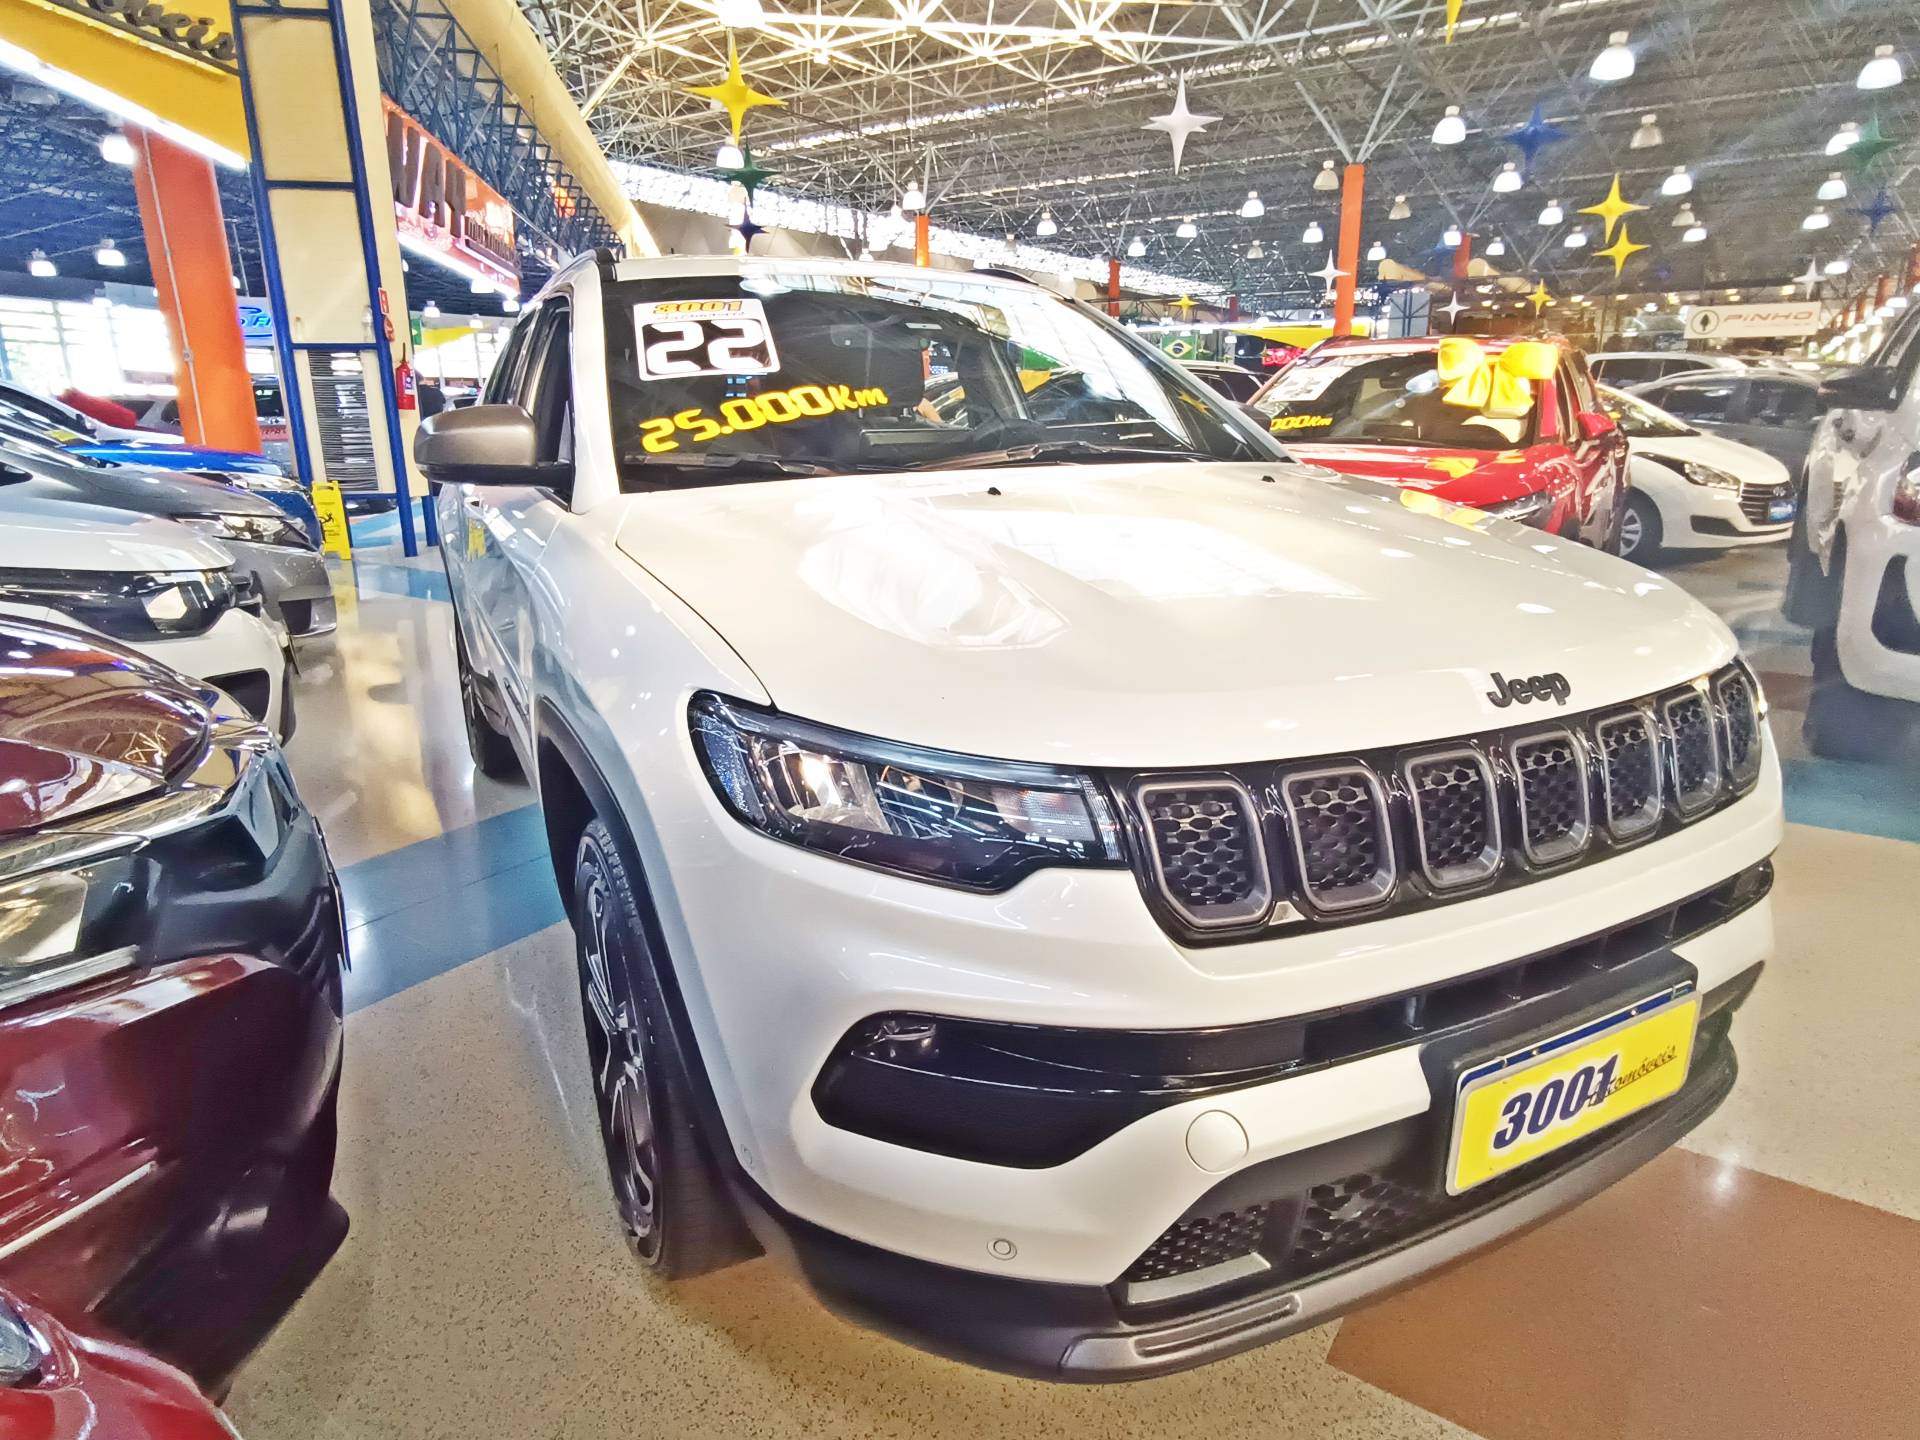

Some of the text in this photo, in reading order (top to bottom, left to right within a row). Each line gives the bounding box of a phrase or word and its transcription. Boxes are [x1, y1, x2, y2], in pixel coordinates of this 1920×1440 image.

[653, 301, 743, 315] 3001
[1722, 311, 1813, 322] PINHO
[646, 319, 766, 375] 22
[1486, 671, 1571, 708] Jeep
[1493, 1053, 1619, 1150] 3001
